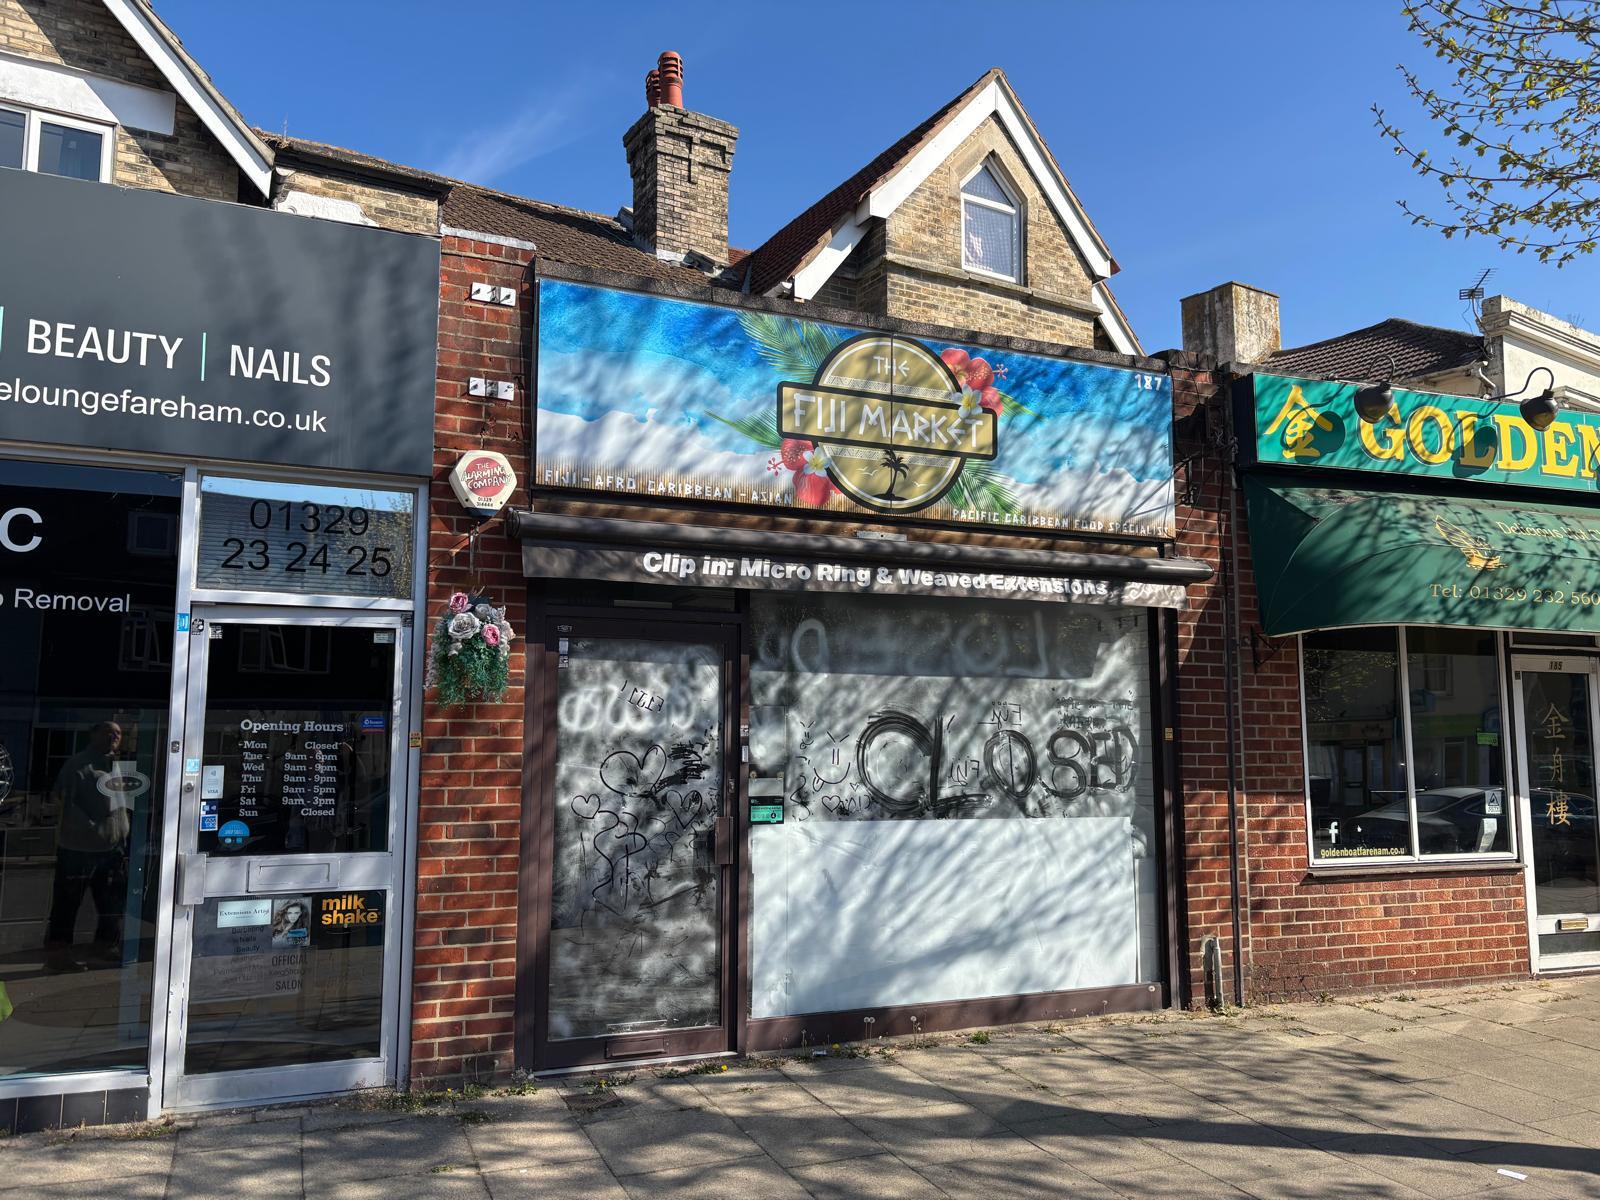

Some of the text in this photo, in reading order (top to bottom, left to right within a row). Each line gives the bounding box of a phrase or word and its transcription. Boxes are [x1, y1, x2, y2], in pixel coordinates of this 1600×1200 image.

[27, 319, 331, 387] BEAUTY NAILS
[874, 355, 911, 377] THE
[1134, 373, 1163, 392] 187
[793, 393, 984, 448] FIJI MARKET
[1264, 384, 1333, 459] 金
[461, 465, 506, 481] ALARMING
[467, 474, 513, 489] COMPANY
[545, 469, 576, 484] FIJI
[648, 480, 733, 499] CARIBBEAN
[751, 490, 793, 506] ASIAN
[249, 499, 370, 537] 01329
[952, 509, 999, 523] PACIFIC
[1004, 514, 1069, 529] CARIBBEAN
[1074, 519, 1103, 531] FOOD
[221, 537, 392, 577] 23 24 25
[642, 551, 696, 577] Clip
[740, 557, 811, 580] Micro
[817, 561, 871, 587] Ring
[876, 566, 894, 585] &
[898, 568, 986, 590] Weaved
[990, 574, 1108, 595] Extensions
[14, 588, 130, 613] Removal
[1429, 584, 1463, 599] Tel:
[1470, 585, 1527, 601] 01329
[1533, 589, 1565, 604] 232
[1549, 661, 1563, 670] 185
[240, 719, 344, 734] Opening Hours
[243, 740, 339, 750] Mon Closed
[242, 751, 263, 760] Tue
[284, 752, 307, 760] 9am
[315, 752, 338, 762] 6pm
[855, 708, 1140, 814] CLOSED
[242, 762, 265, 771] Wed
[284, 763, 307, 771] 9am
[314, 763, 337, 773] 9pm
[241, 774, 262, 782] Thu
[283, 774, 306, 782] 9am
[314, 774, 337, 784] 9pm
[240, 785, 256, 794] Fri
[313, 785, 336, 795] 5pm
[239, 796, 257, 805] Sat
[281, 797, 305, 805] 9am
[312, 797, 336, 807] 3pm
[238, 807, 335, 817] Sun Closed
[321, 909, 379, 926] shake
